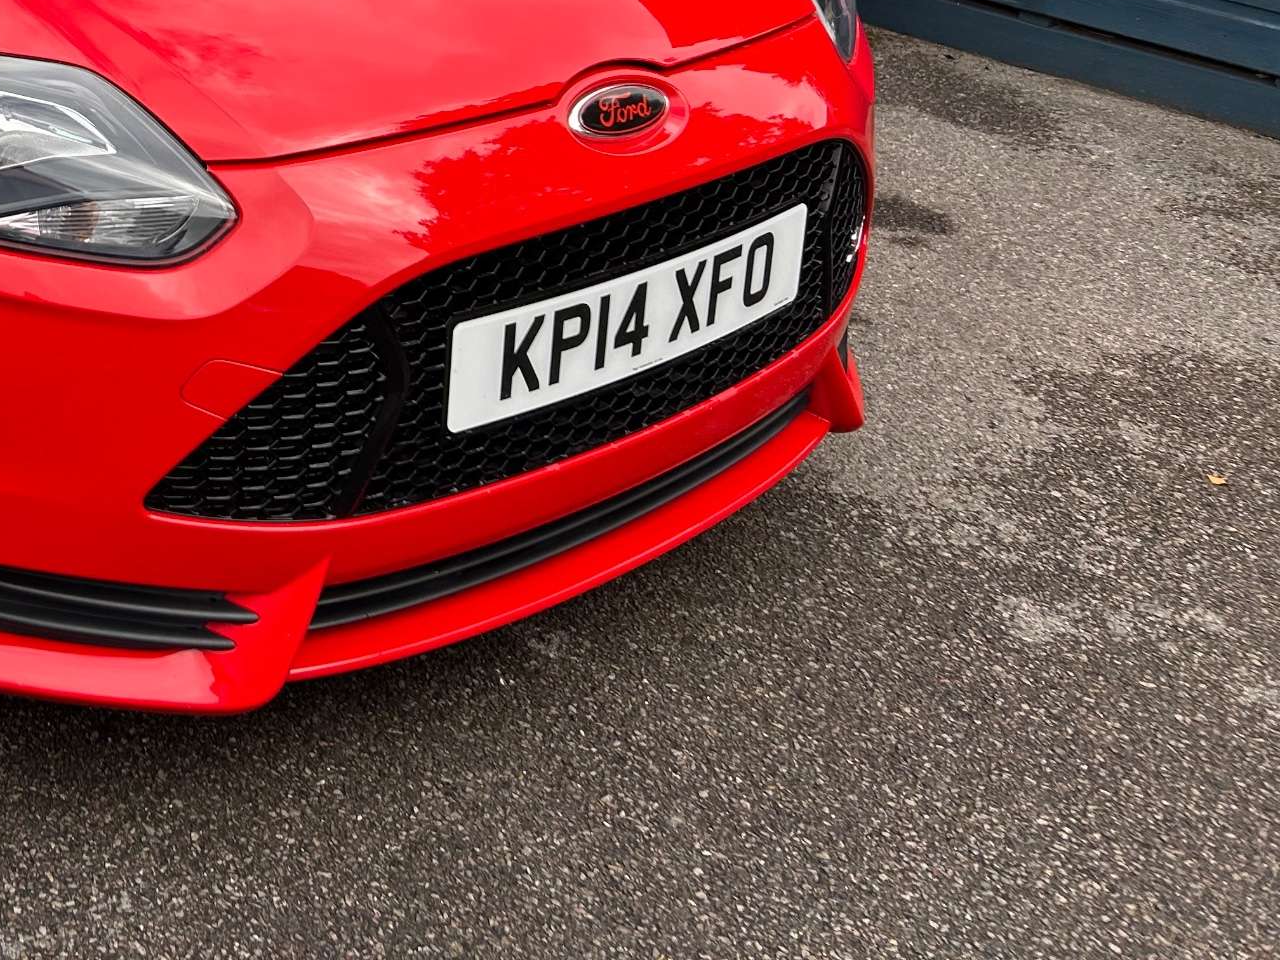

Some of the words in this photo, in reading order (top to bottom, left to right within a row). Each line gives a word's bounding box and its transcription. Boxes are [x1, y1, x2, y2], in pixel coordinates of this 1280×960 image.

[599, 91, 652, 127] Ford
[499, 281, 650, 401] KP14
[669, 232, 775, 343] XFO
